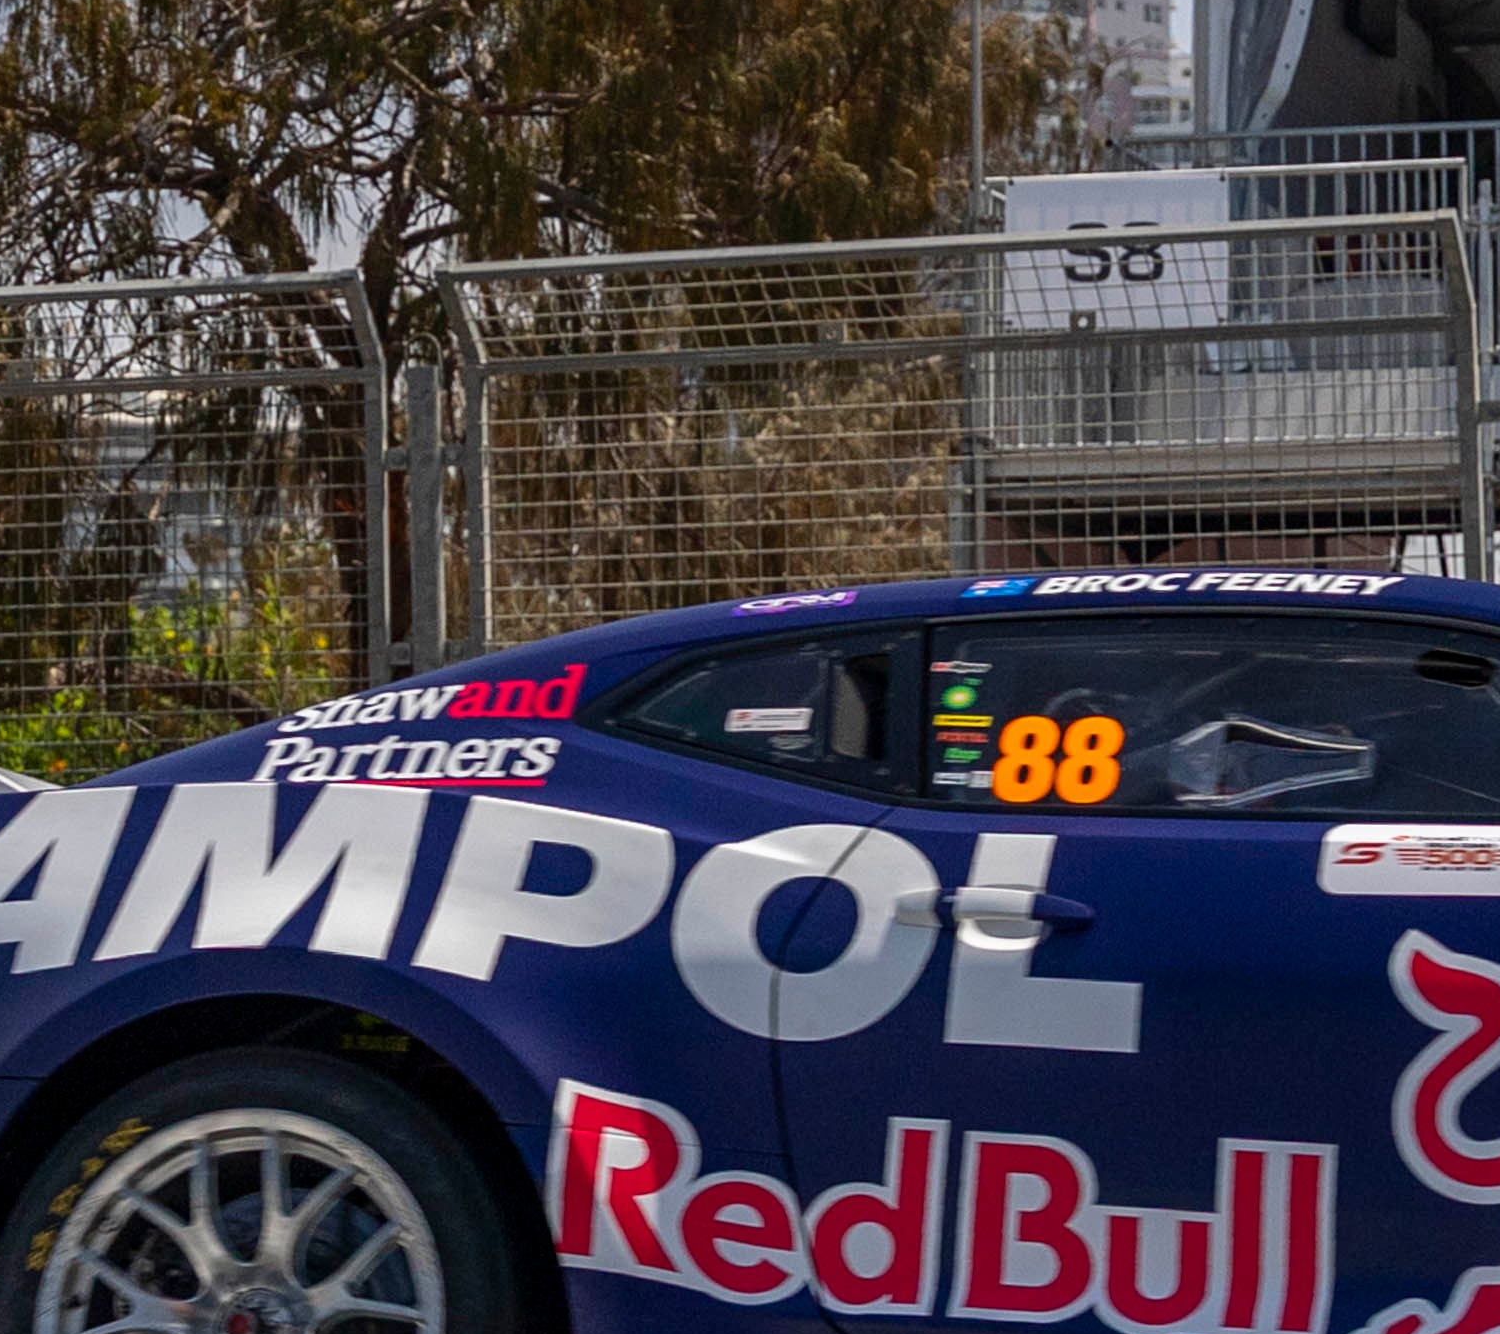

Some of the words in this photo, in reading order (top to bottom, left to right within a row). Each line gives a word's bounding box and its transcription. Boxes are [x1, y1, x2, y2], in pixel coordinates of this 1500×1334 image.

[1033, 573, 1182, 595] BROC
[1186, 572, 1404, 596] FEENEY
[252, 735, 562, 783] Partners
[992, 715, 1126, 805] 88
